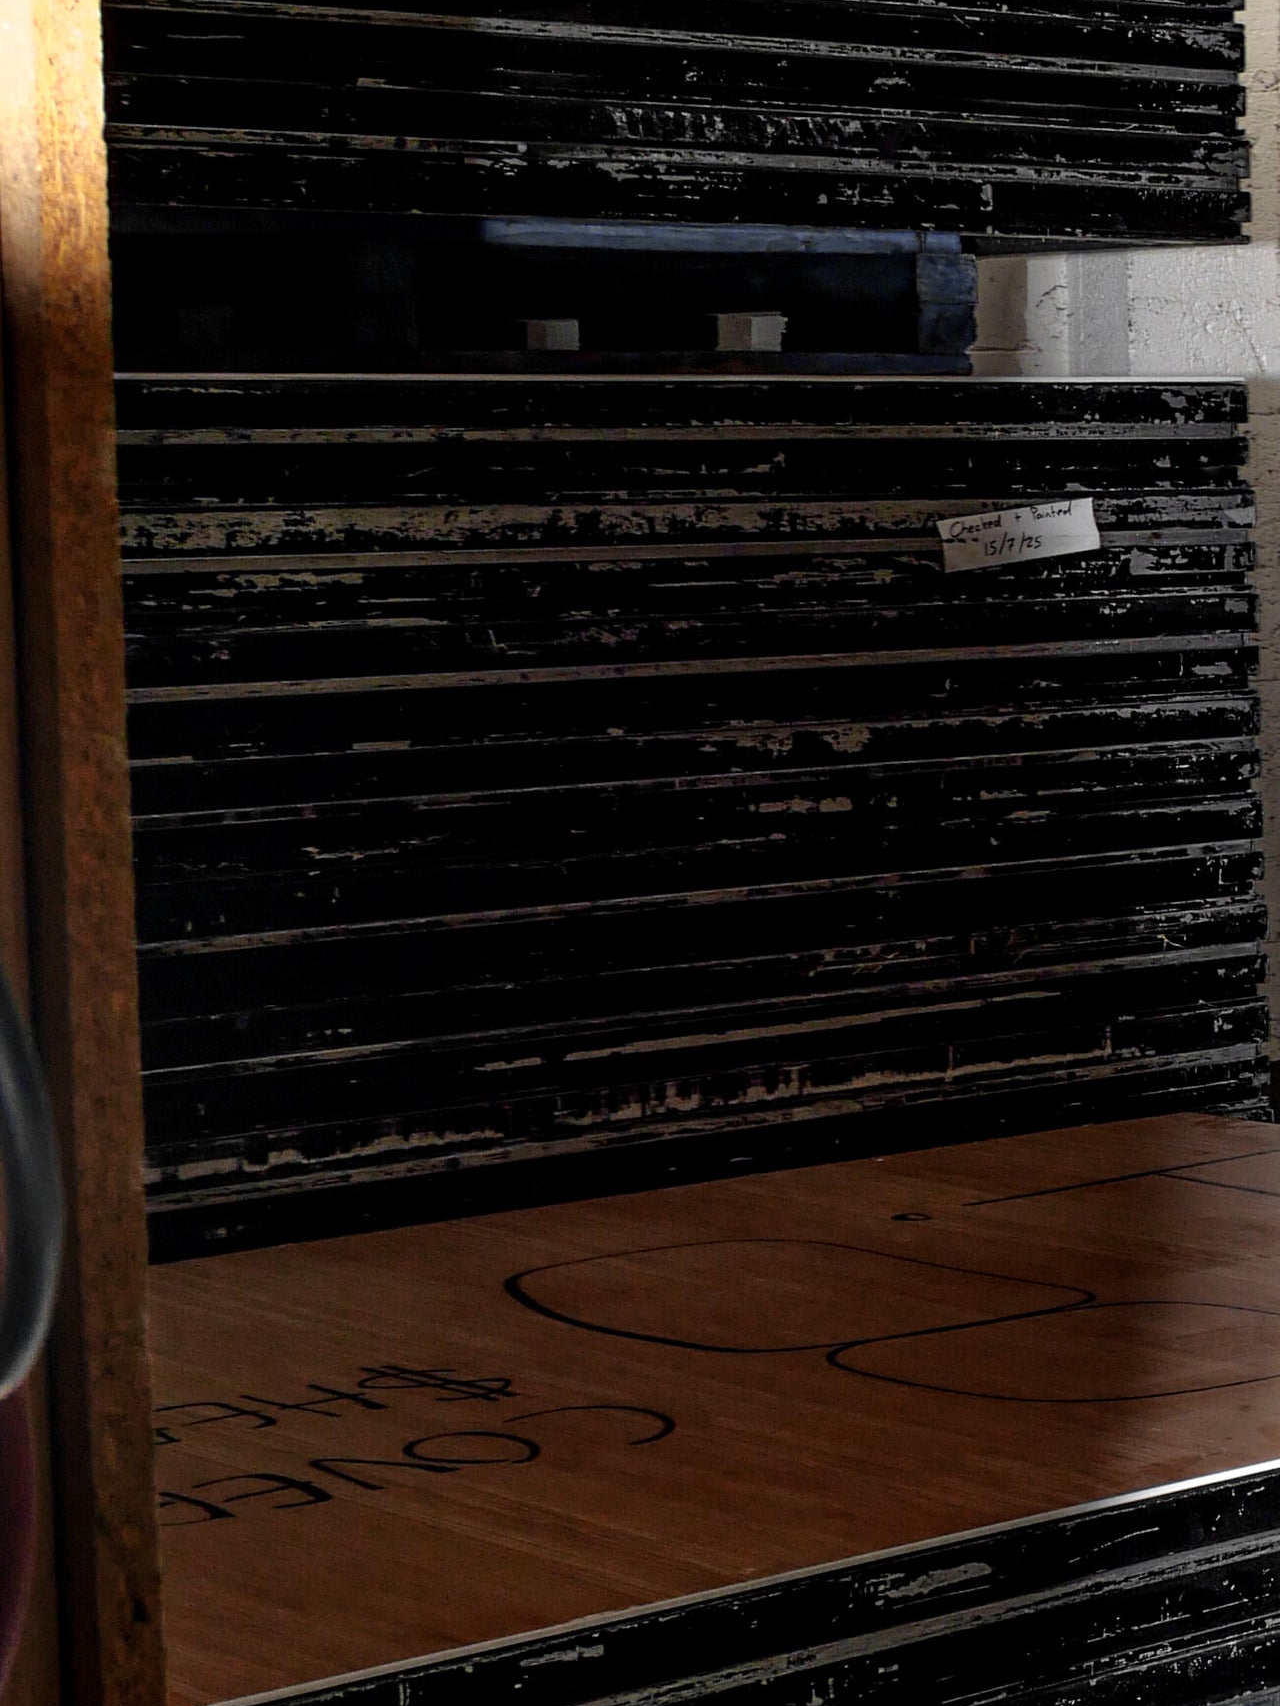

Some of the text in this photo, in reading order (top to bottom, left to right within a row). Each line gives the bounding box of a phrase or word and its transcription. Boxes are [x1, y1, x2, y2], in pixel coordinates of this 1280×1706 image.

[950, 515, 1002, 538] Checked
[1029, 501, 1072, 521] Painted
[984, 531, 1042, 557] 15/7/25
